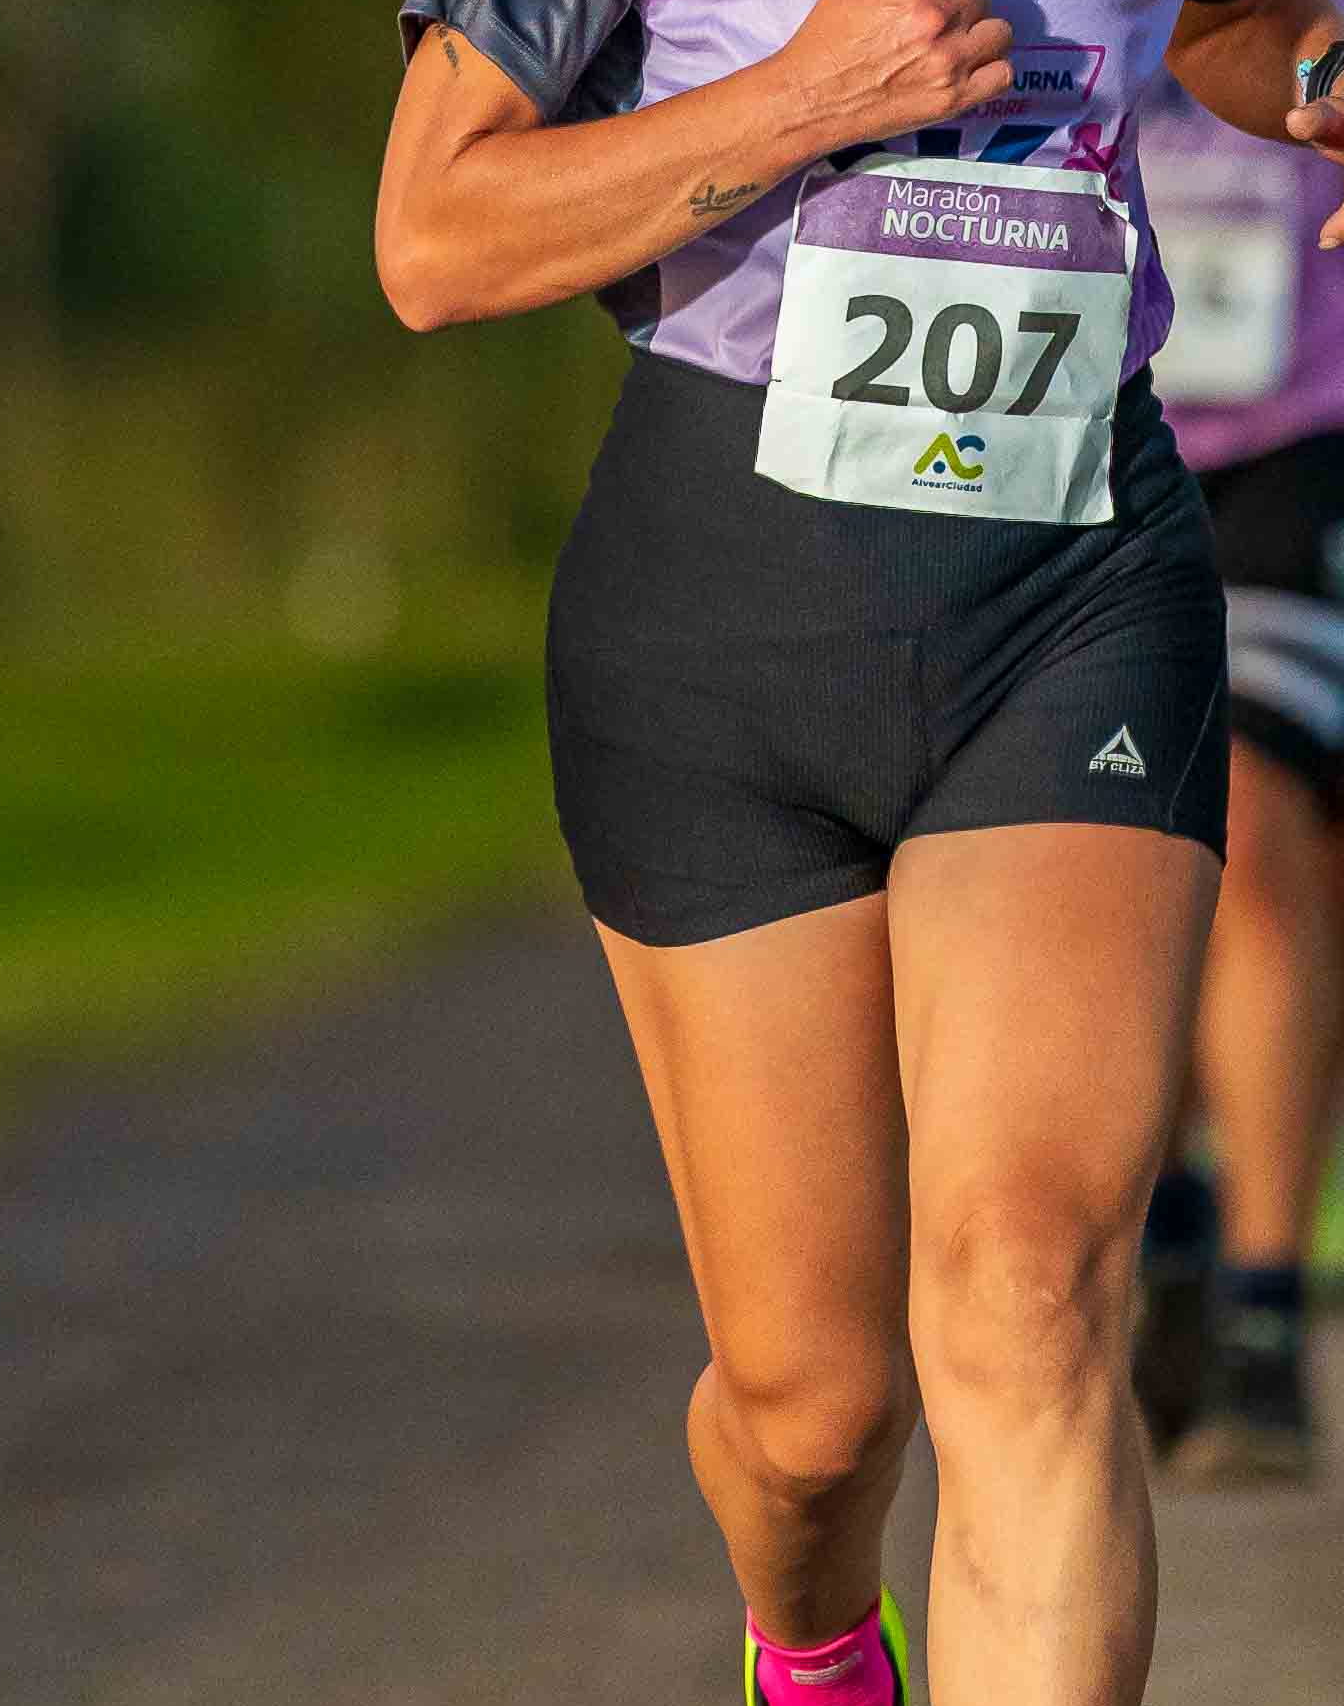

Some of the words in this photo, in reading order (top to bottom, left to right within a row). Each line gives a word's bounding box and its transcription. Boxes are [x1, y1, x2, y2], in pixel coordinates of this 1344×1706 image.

[1012, 70, 1074, 91] URNA
[887, 179, 1001, 213] Maratón
[882, 208, 1070, 251] NOCTURNA
[831, 294, 1082, 416] 207
[911, 478, 984, 493] AlvearCiudad
[1089, 760, 1107, 771] BY
